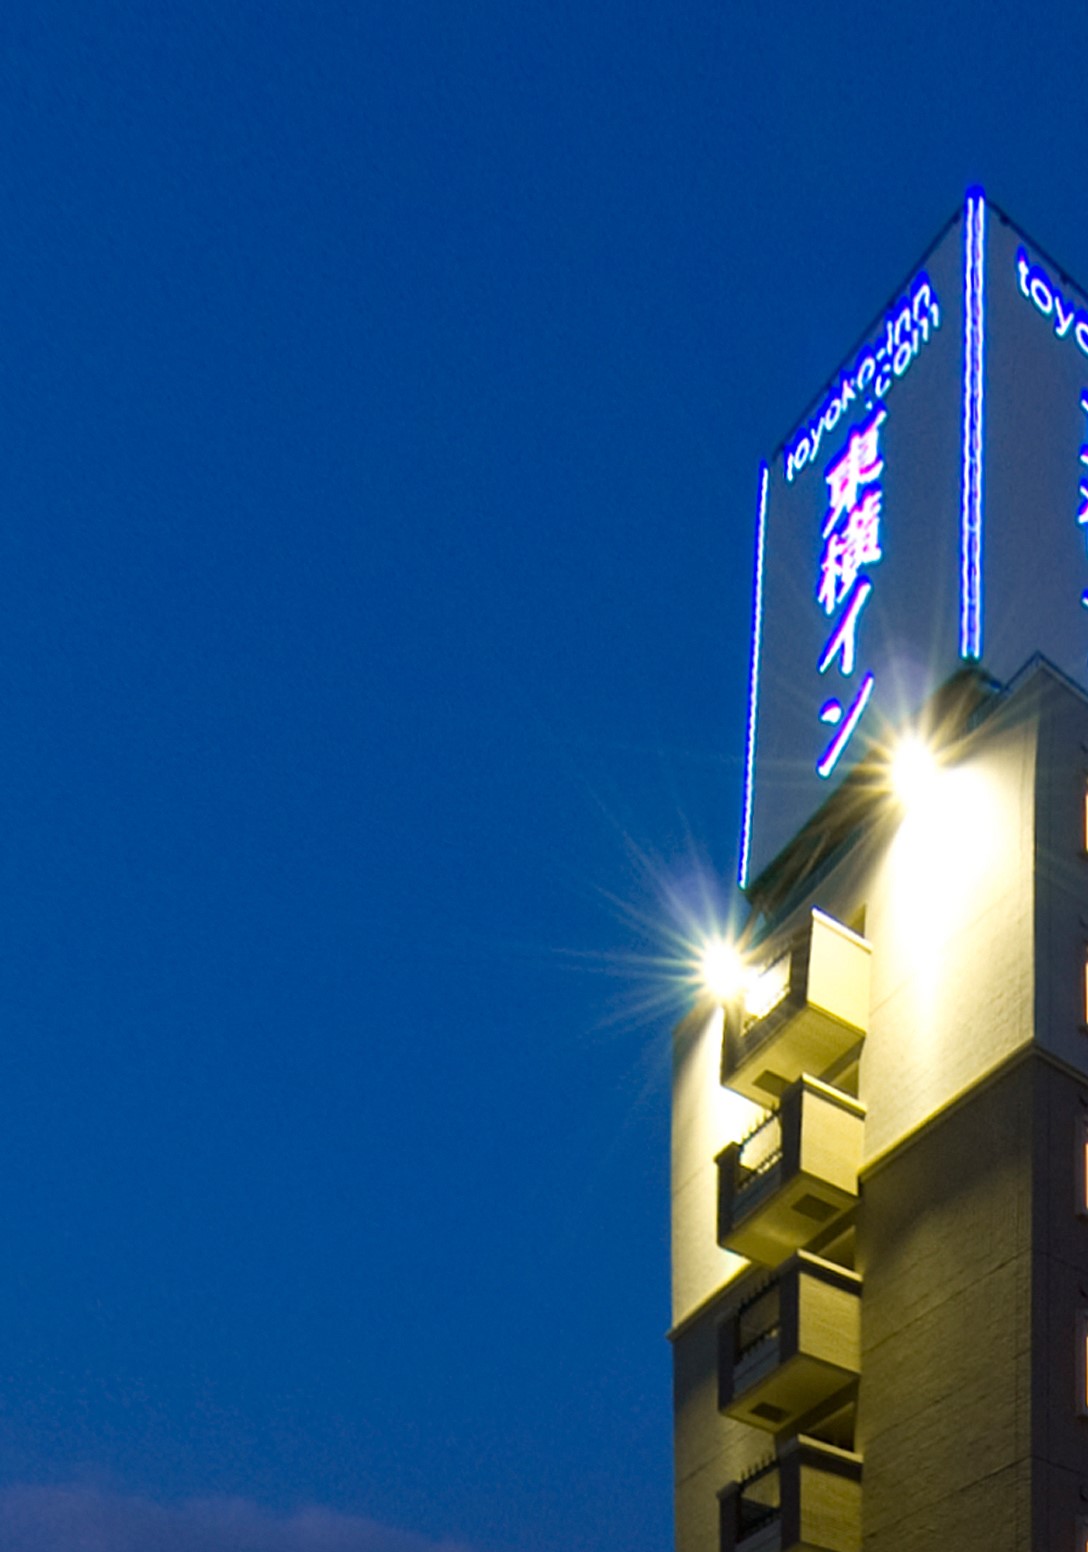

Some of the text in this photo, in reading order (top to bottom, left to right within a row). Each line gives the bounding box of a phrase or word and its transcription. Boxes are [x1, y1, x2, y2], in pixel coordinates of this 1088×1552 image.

[785, 272, 931, 482] toyoko-inn
[818, 403, 887, 777] 東横イン
